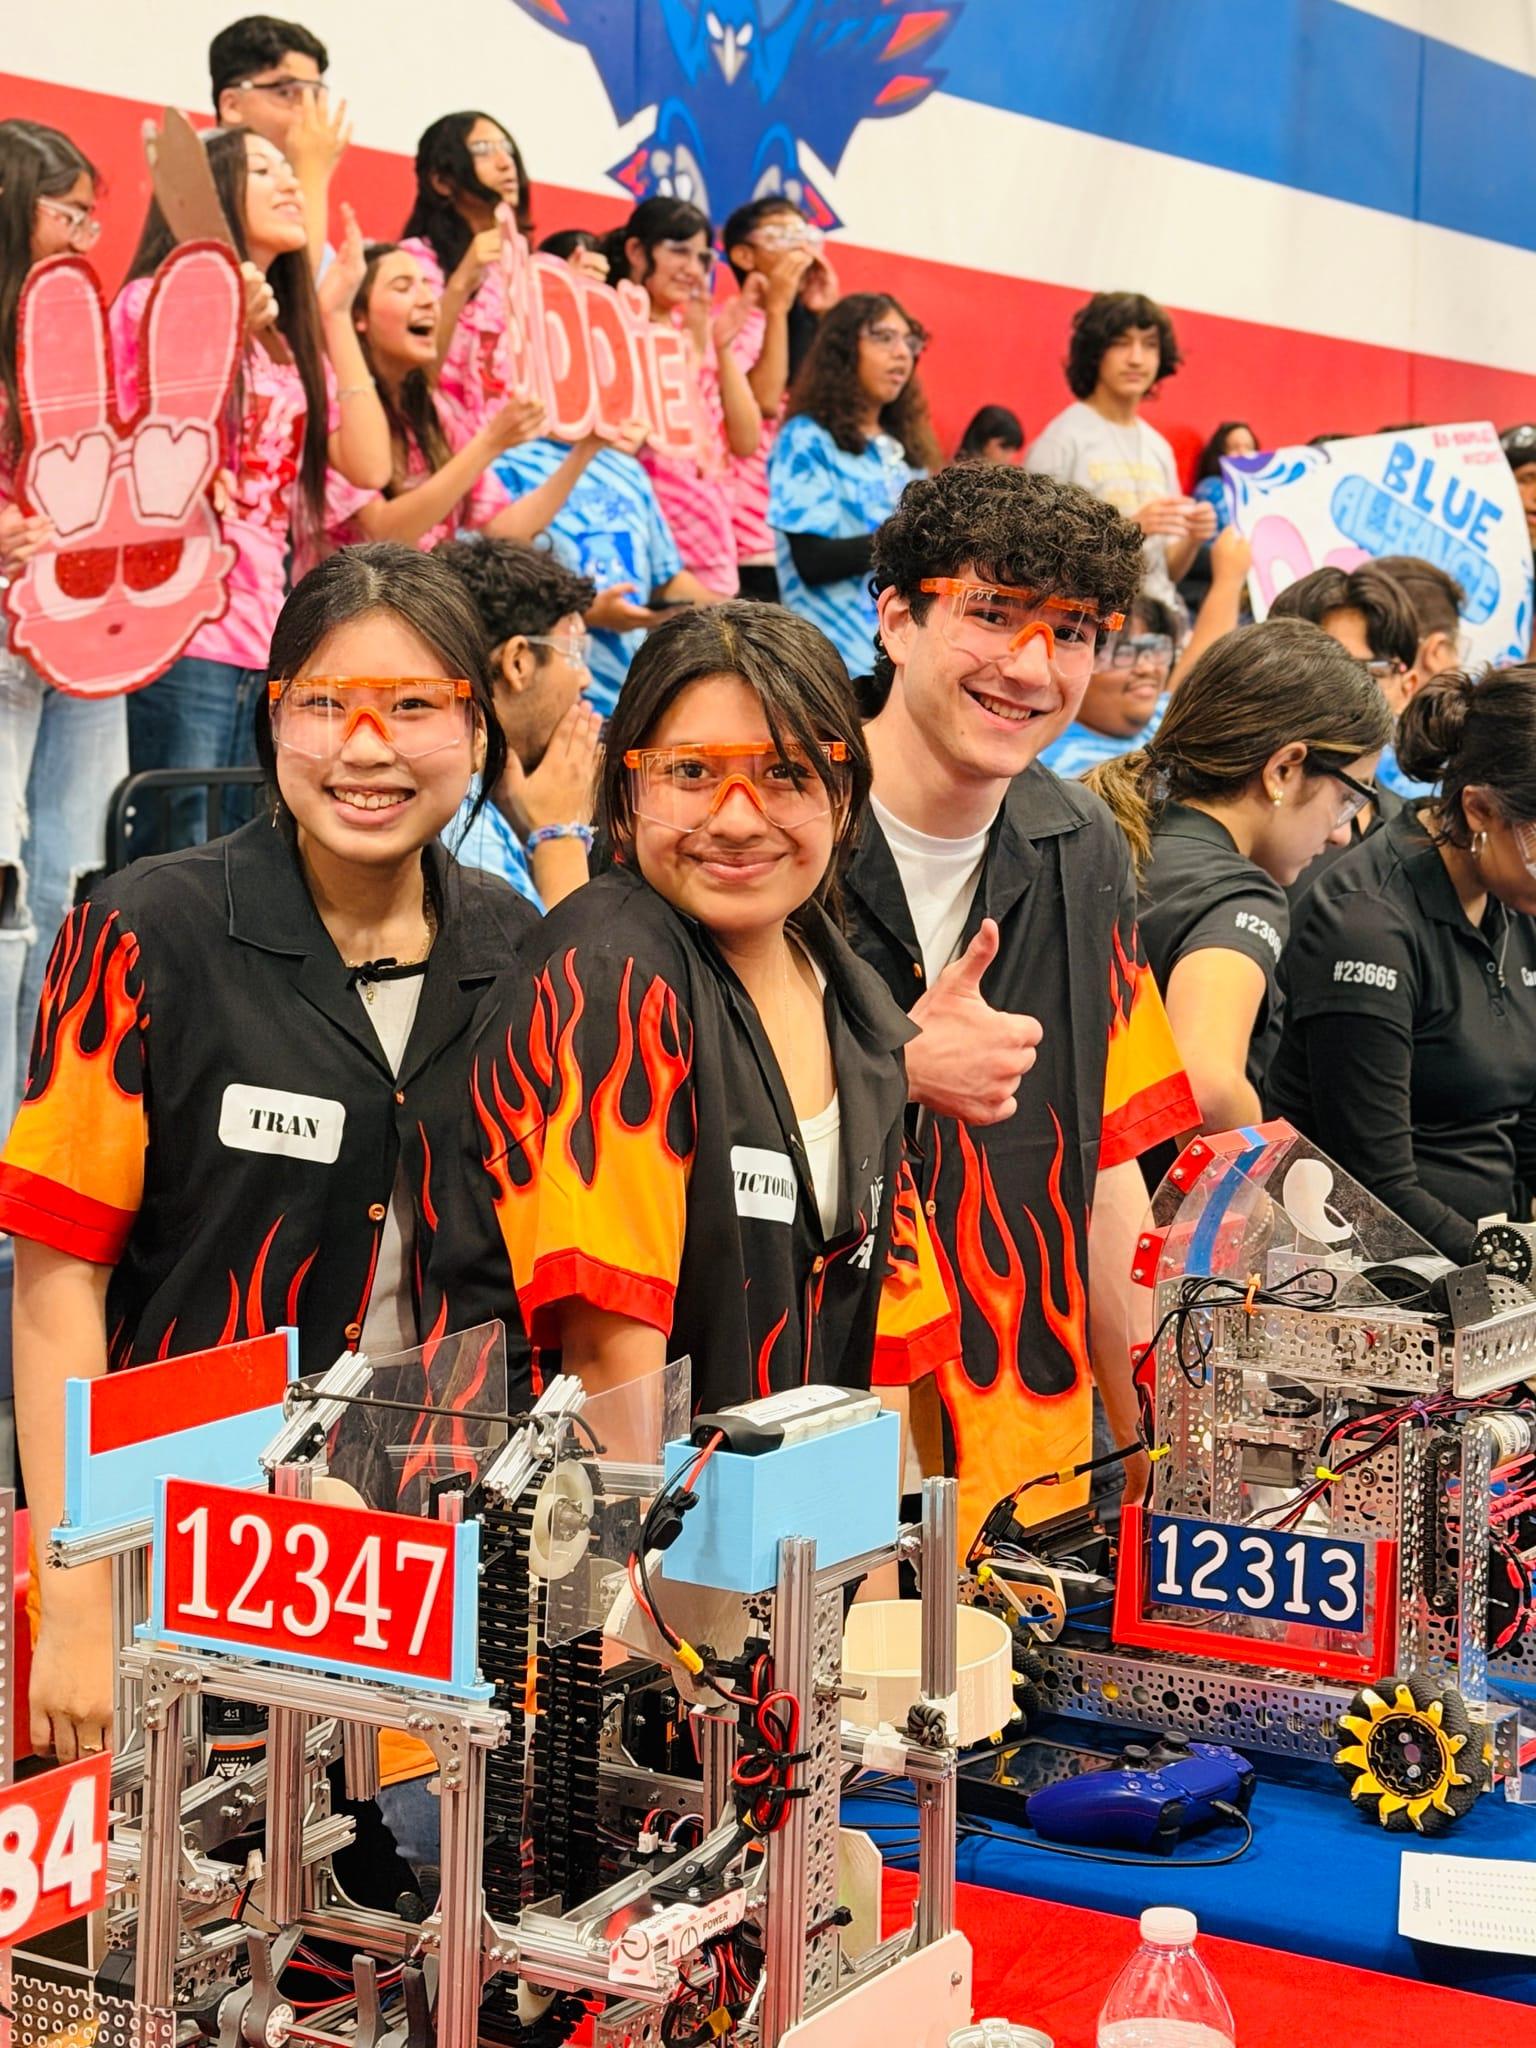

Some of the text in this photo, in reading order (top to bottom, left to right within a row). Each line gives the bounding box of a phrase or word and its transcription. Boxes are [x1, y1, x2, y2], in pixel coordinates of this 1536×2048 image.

[1383, 441, 1503, 551] BLUE
[1333, 960, 1399, 991] #23665
[249, 1108, 320, 1139] TRAN
[176, 1507, 448, 1657] 12347
[1157, 1524, 1357, 1622] 12313
[224, 1708, 241, 1719] 4:1
[702, 1911, 729, 1933] POWER
